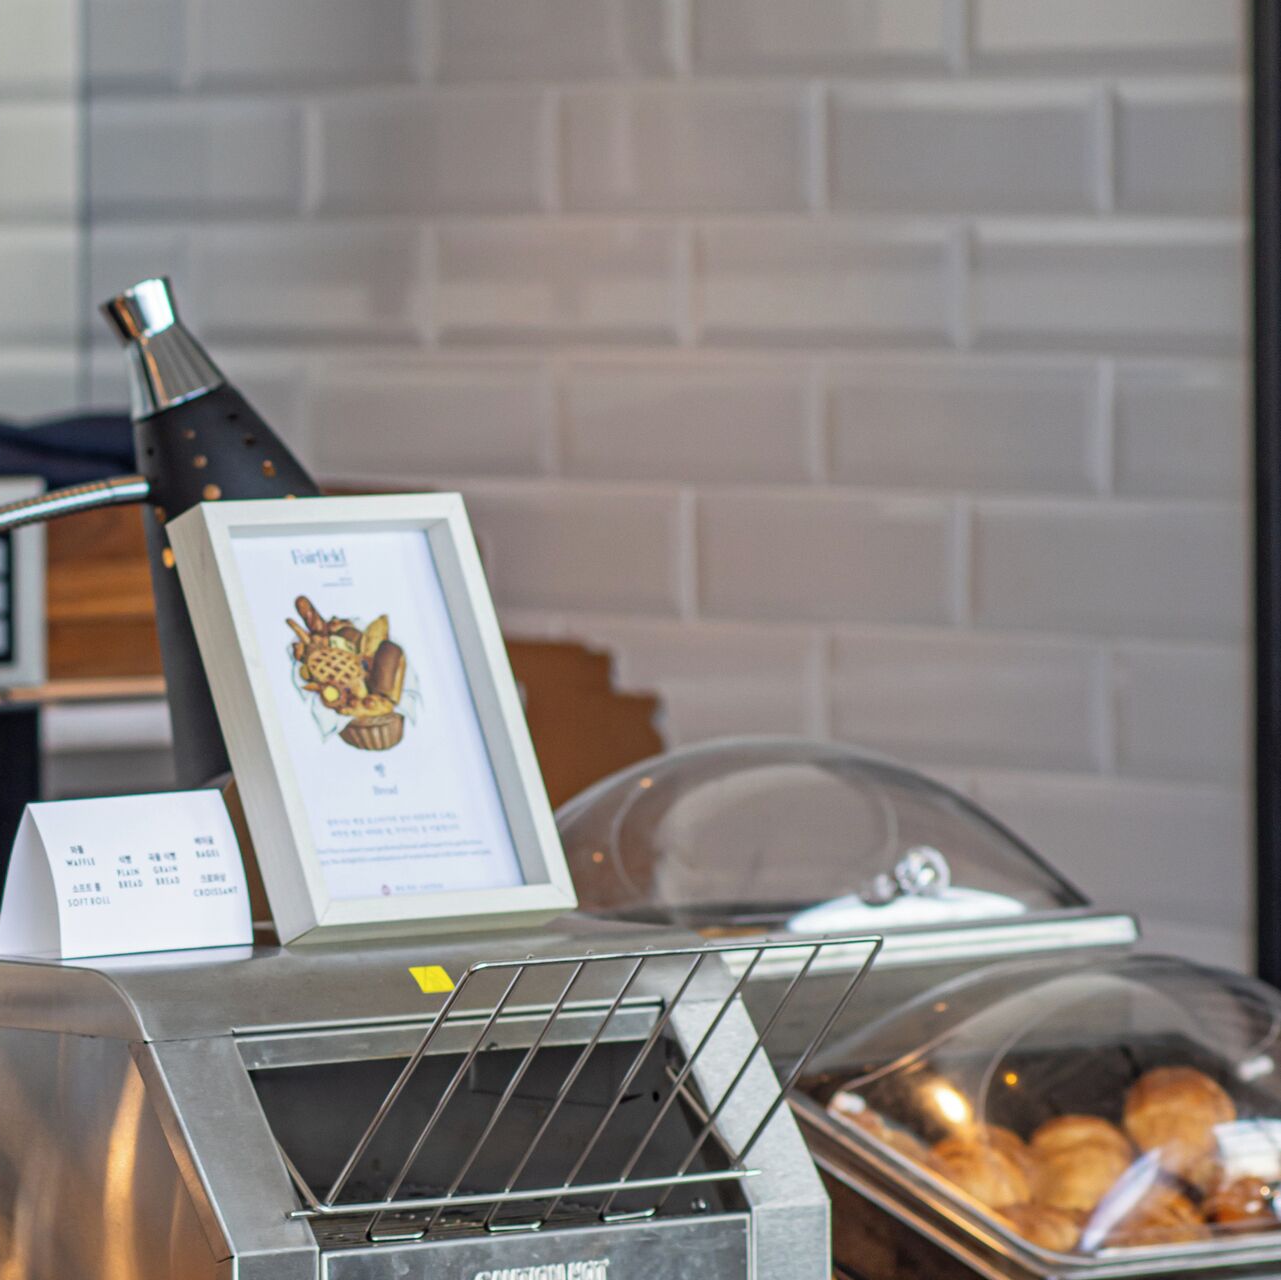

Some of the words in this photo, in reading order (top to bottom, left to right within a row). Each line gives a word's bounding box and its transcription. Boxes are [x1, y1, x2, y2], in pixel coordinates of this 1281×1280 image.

[195, 849, 220, 858] BAGEL
[65, 857, 96, 867] WAFFLE
[116, 869, 140, 878] PLAIN
[153, 865, 178, 875] GRAIN
[118, 879, 144, 889] BREAD
[155, 876, 180, 886] BREAD
[193, 886, 238, 898] CROISSANT
[68, 897, 88, 908] SOFT
[90, 895, 111, 906] ROLL
